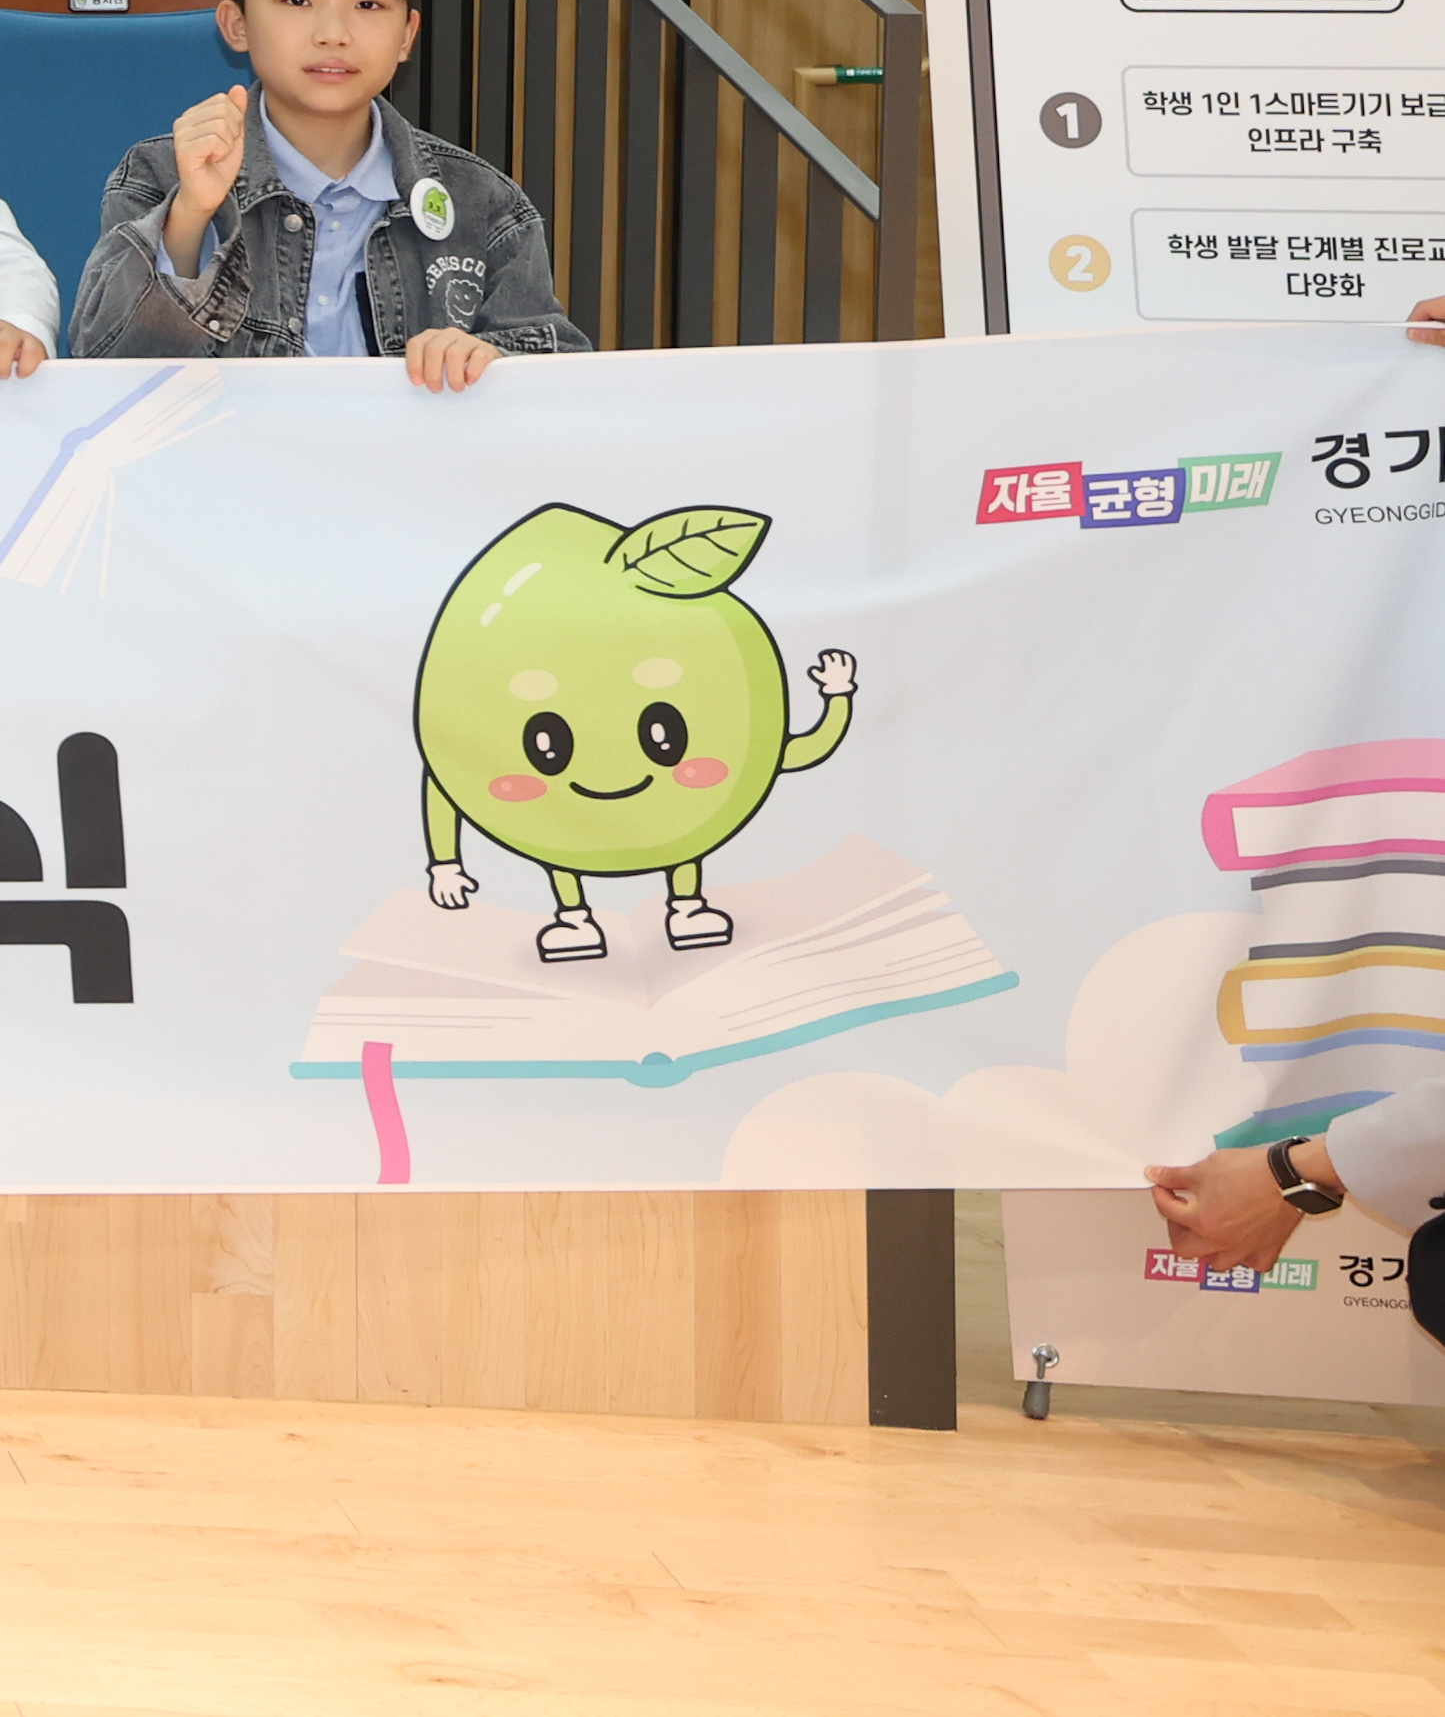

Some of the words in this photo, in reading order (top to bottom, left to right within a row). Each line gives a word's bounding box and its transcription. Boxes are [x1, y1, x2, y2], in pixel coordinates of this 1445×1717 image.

[1142, 90, 1193, 117] 학생
[1201, 91, 1241, 117] 1인
[1250, 92, 1392, 118] 1스마트기기
[1401, 93, 1445, 119] 보급
[1055, 101, 1080, 140] 1
[1248, 127, 1325, 154] 인프라
[1332, 128, 1382, 154] 구축
[1167, 233, 1219, 261] 학생
[1227, 235, 1279, 261] 발달
[1287, 236, 1366, 262] 단계별
[1374, 237, 1445, 263] 진로교
[1065, 244, 1095, 282] 2
[1286, 271, 1366, 299] 다양화
[986, 470, 1073, 515] 자율
[1088, 477, 1176, 522] 균형
[1189, 460, 1271, 504] 미래
[1263, 1263, 1312, 1287] 미래
